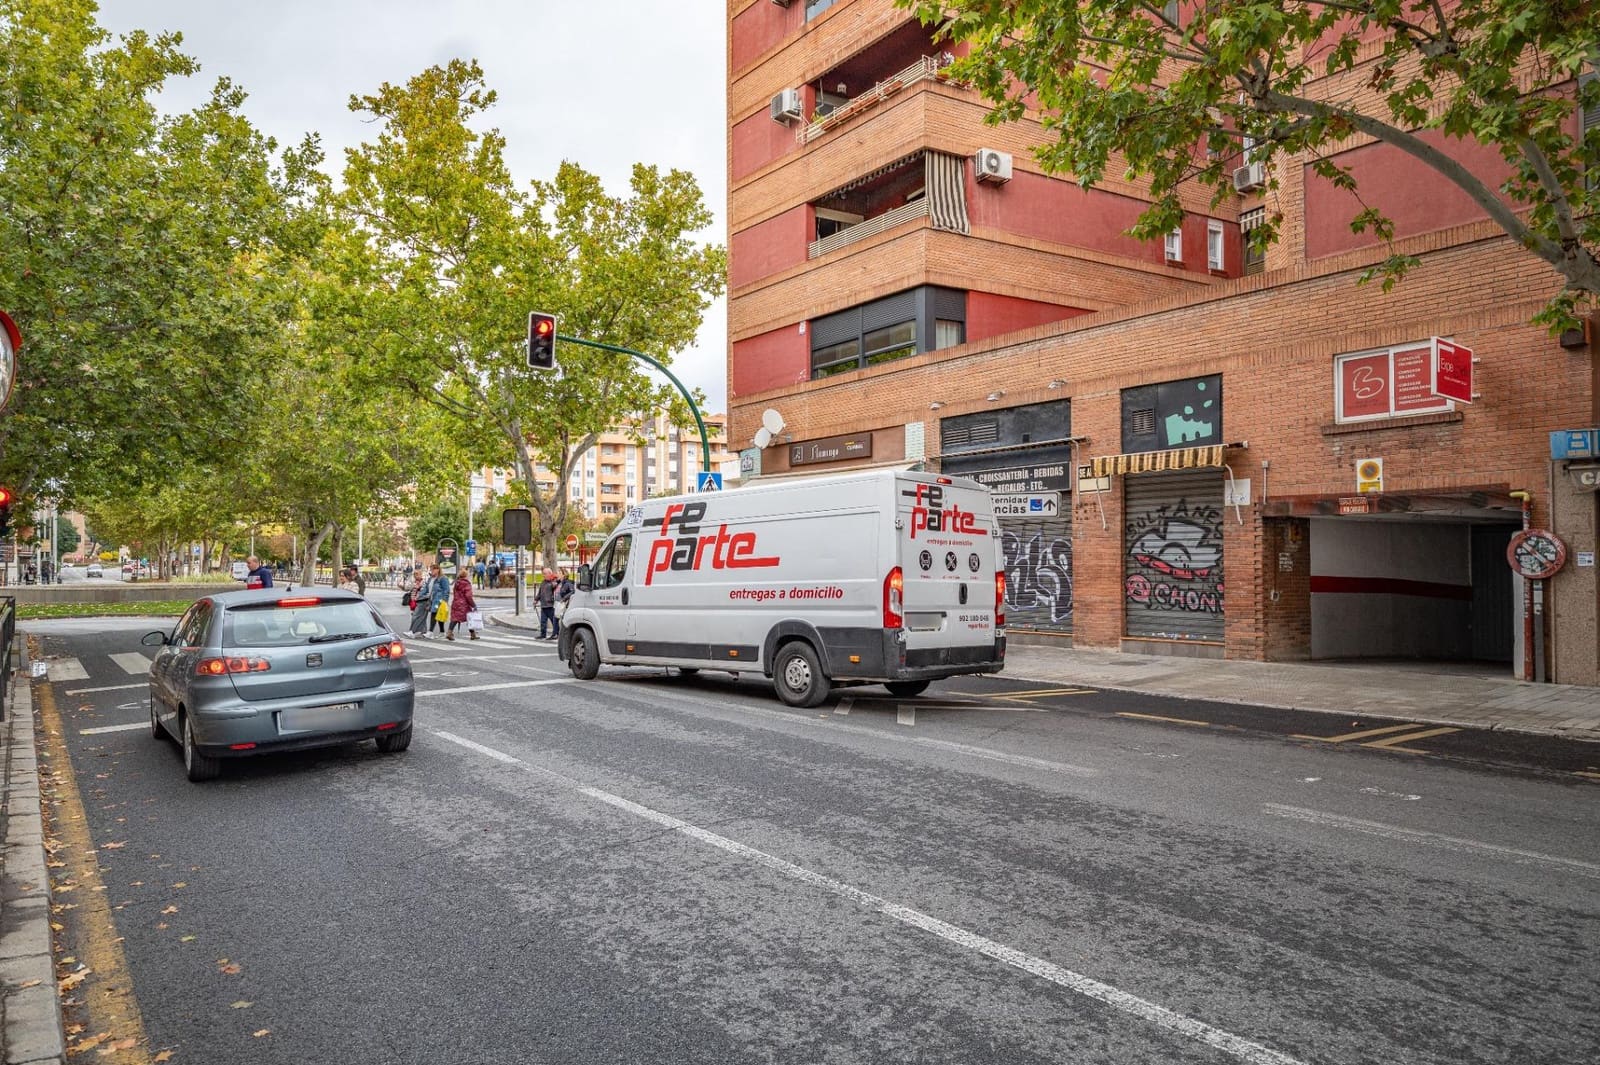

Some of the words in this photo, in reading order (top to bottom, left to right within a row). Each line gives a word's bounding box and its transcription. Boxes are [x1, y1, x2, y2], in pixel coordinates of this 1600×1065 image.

[1033, 466, 1064, 478] BEBIDAS
[997, 480, 1026, 493] REGALOS
[992, 496, 1028, 504] ernidad
[993, 505, 1027, 514] ncias
[910, 504, 988, 540] parte
[926, 538, 949, 547] entregas
[952, 539, 973, 547] domicilio
[645, 523, 780, 586] parte
[729, 588, 777, 601] entregas
[779, 589, 786, 599] a
[789, 586, 843, 599] domicilio
